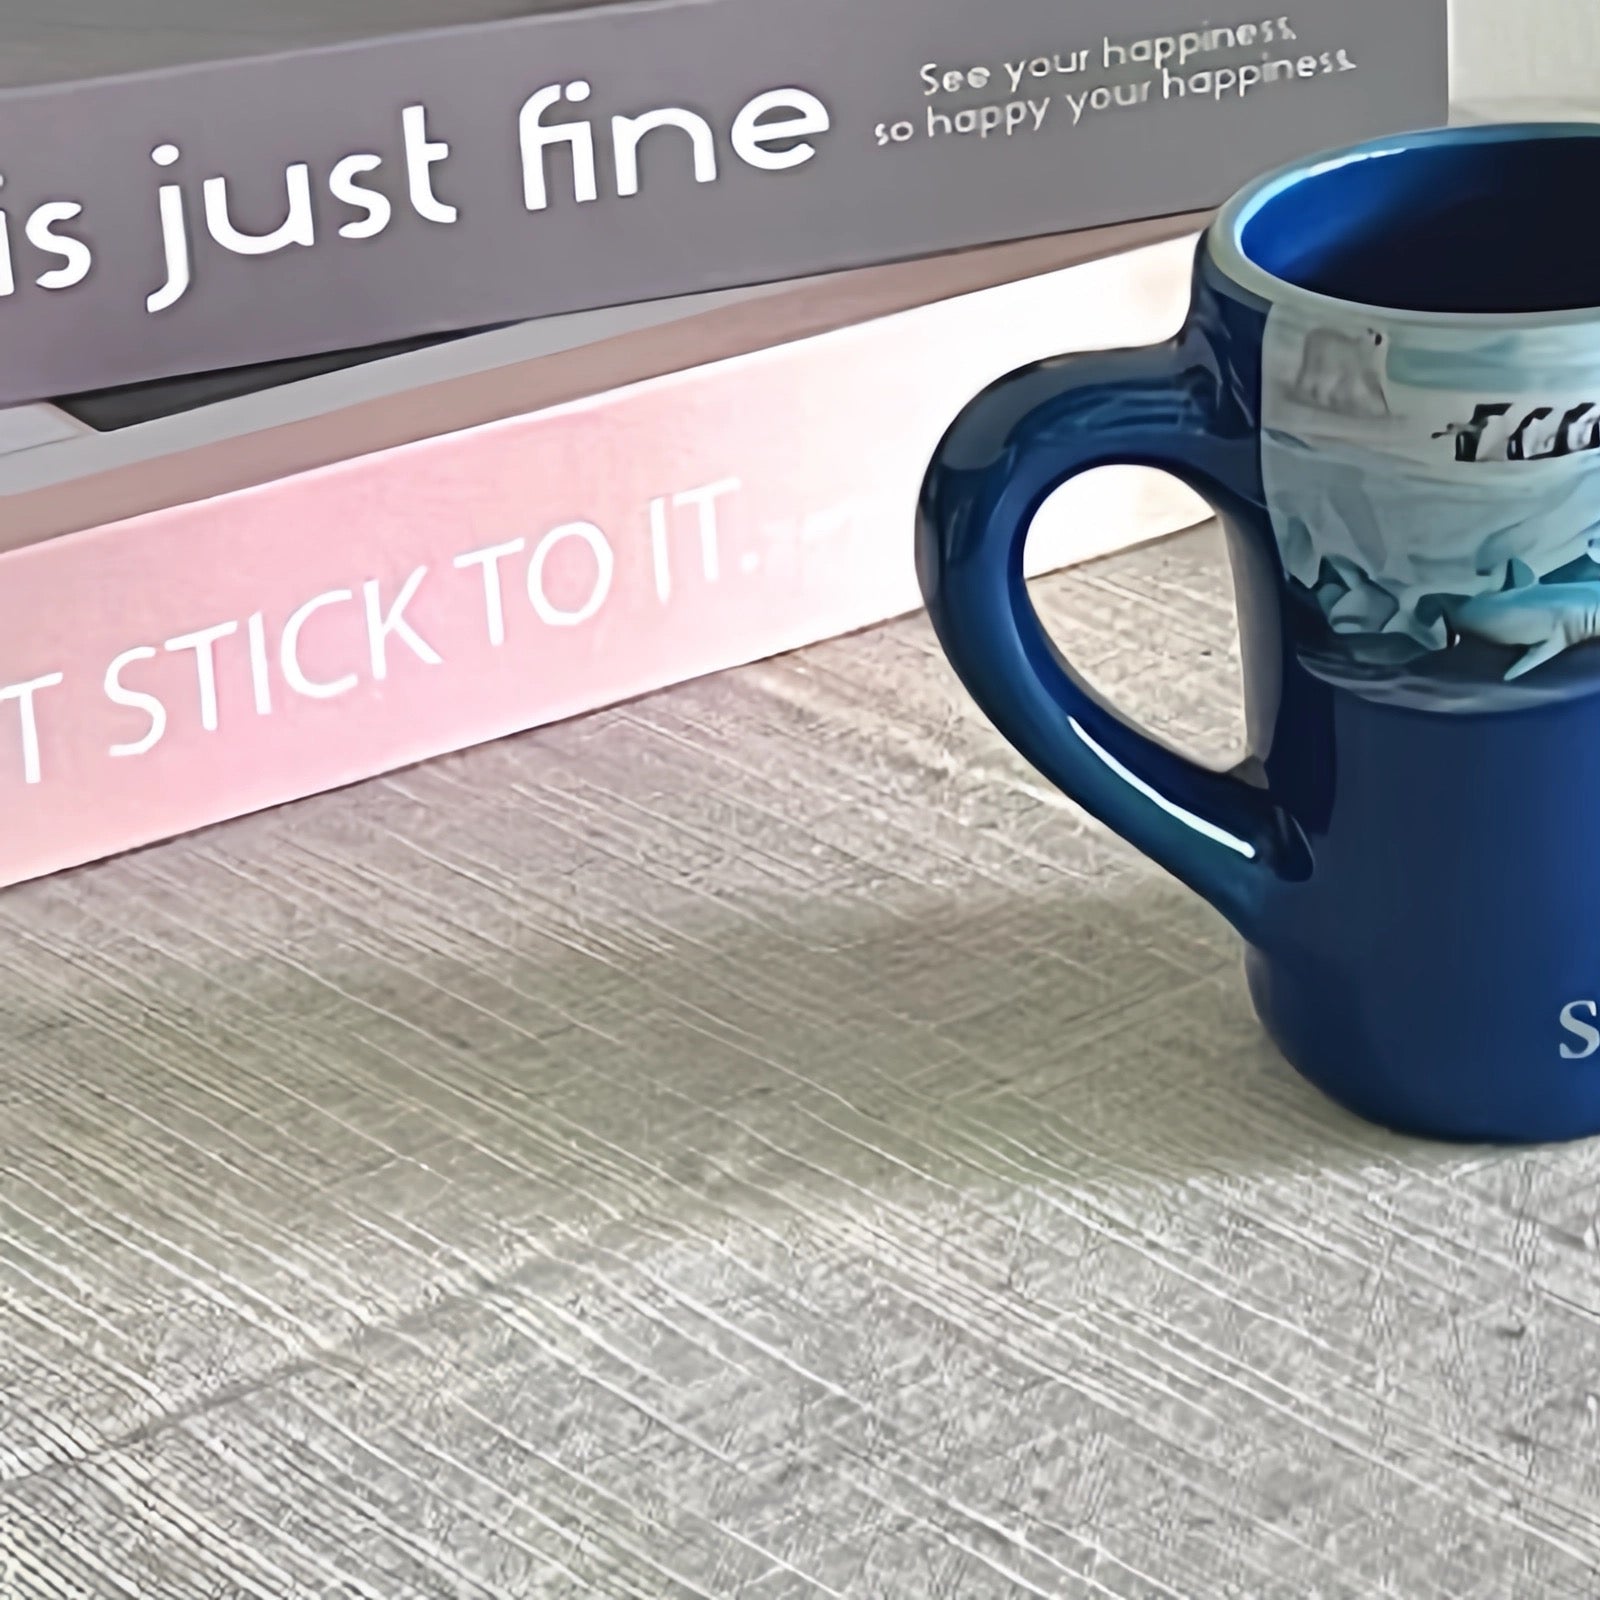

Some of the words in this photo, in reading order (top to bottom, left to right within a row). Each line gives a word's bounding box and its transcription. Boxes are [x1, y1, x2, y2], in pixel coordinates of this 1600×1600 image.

[874, 120, 915, 146] so
[926, 96, 1051, 139] happy
[1065, 80, 1152, 127] your
[919, 62, 991, 96] See
[1003, 49, 1090, 93] your
[146, 104, 458, 313] just
[518, 80, 831, 211] fine
[103, 565, 443, 758] STICK
[453, 520, 616, 647] TO
[646, 474, 763, 604] IT.
